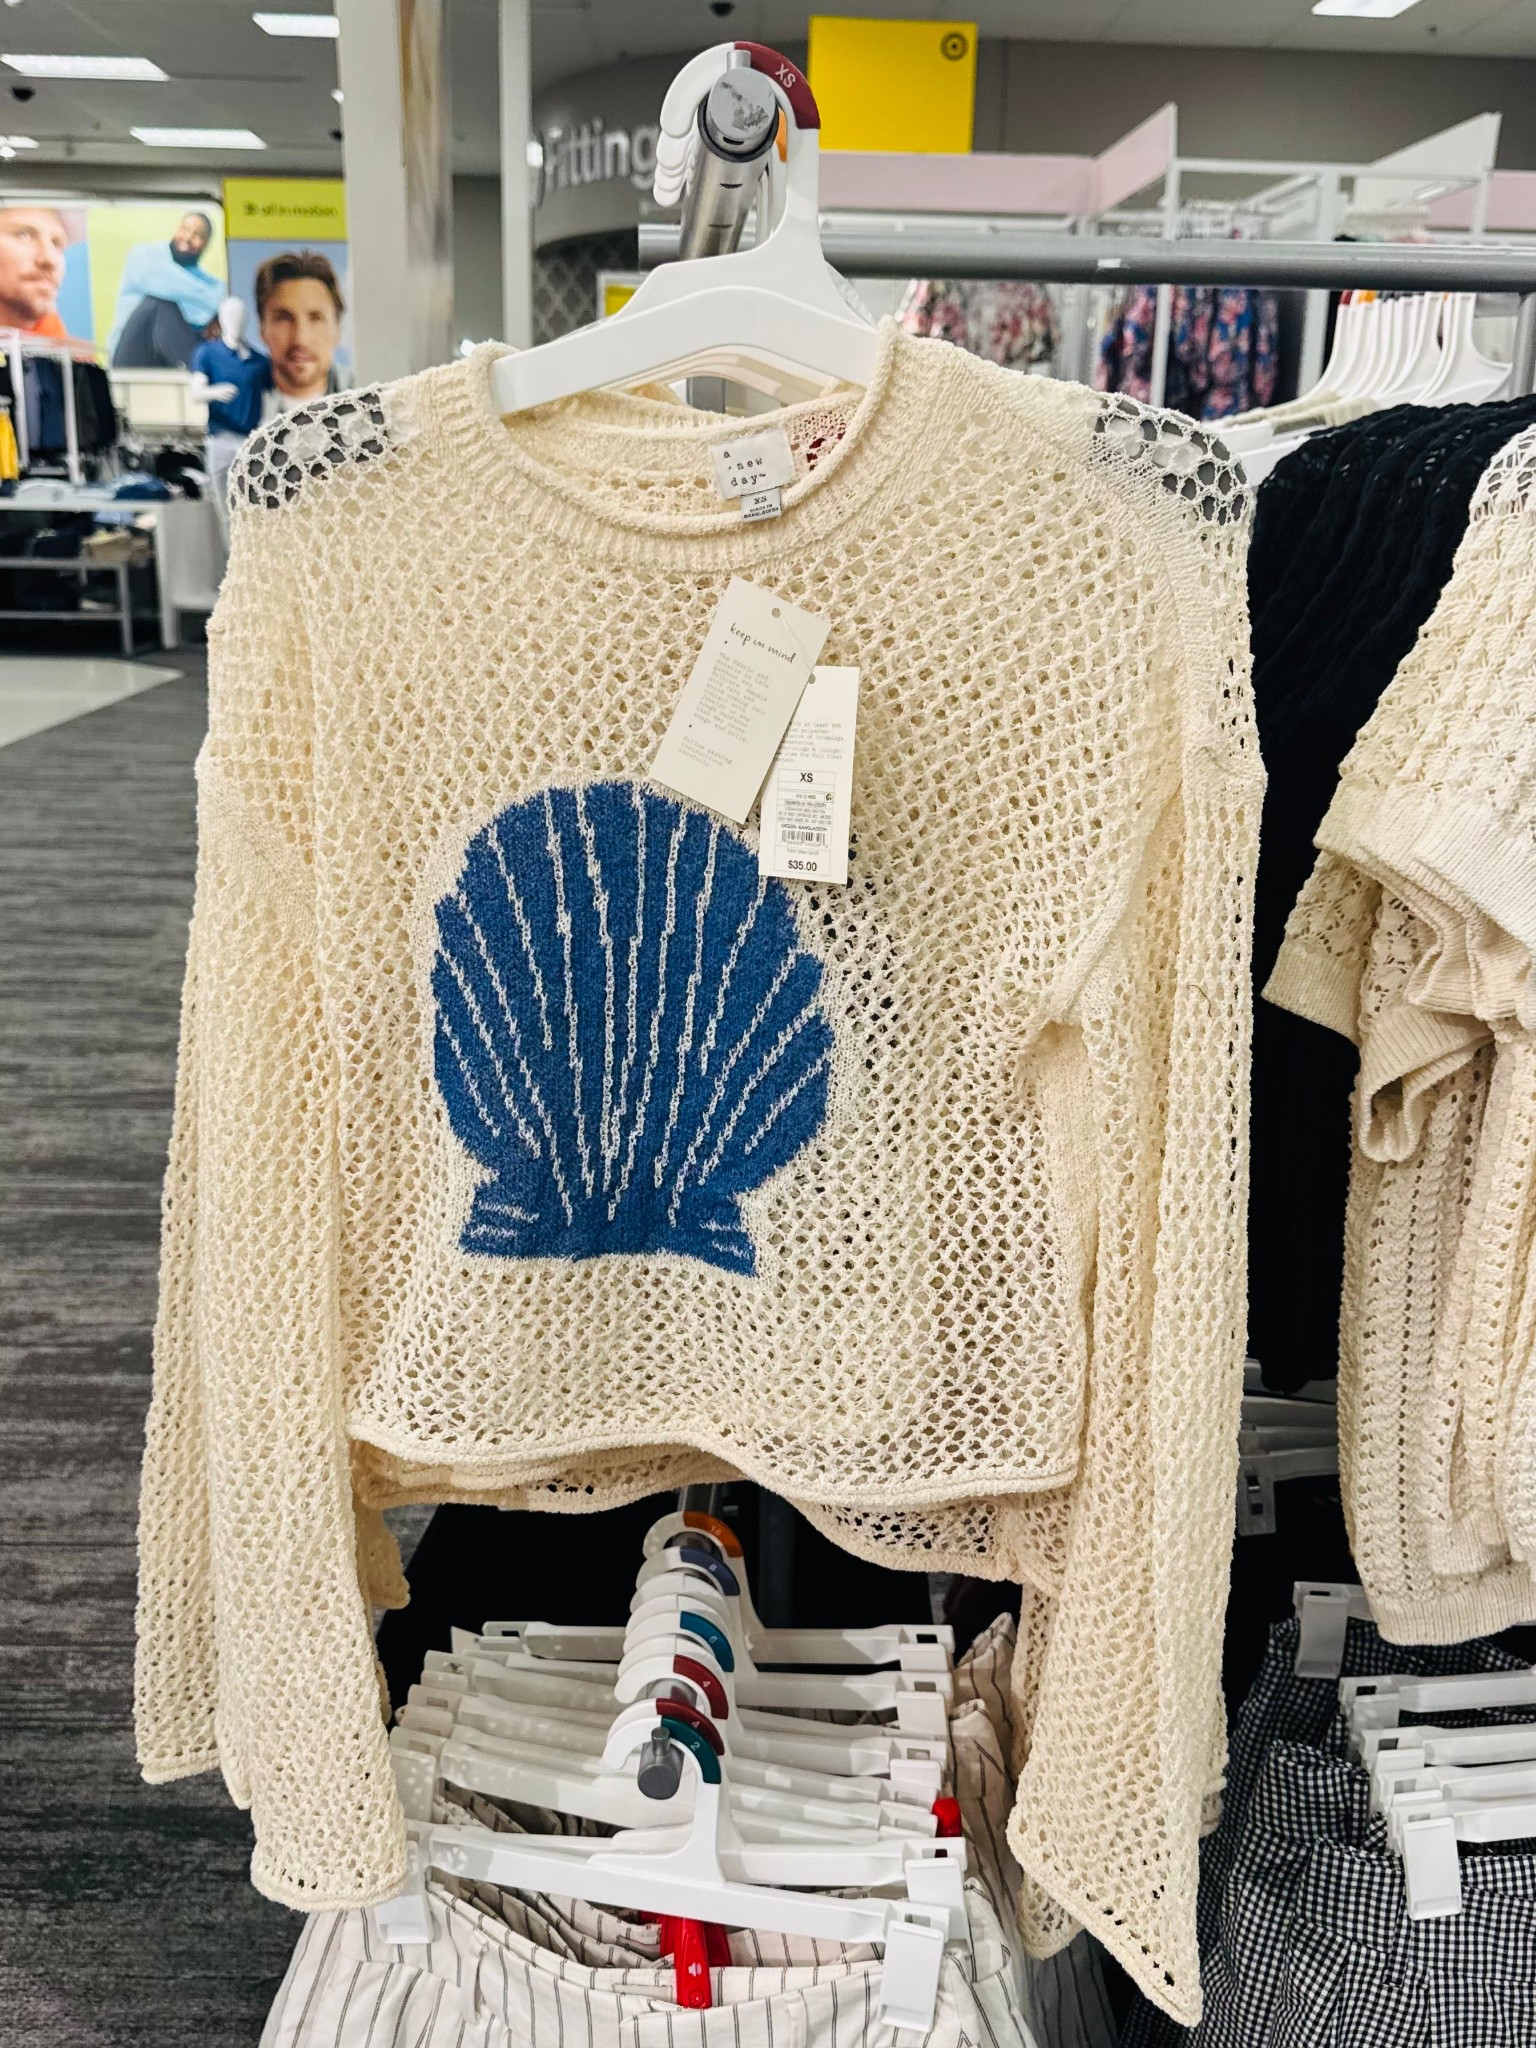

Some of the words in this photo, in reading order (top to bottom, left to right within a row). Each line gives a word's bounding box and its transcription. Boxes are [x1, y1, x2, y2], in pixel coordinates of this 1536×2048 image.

[774, 63, 797, 89] XS
[544, 116, 659, 191] Fitting
[723, 451, 731, 459] a
[736, 457, 763, 471] new
[753, 495, 768, 505] XS
[730, 622, 751, 647] keep
[753, 638, 765, 650] in
[768, 644, 797, 664] mind
[800, 772, 814, 783] XS
[788, 859, 818, 872] $35.00
[708, 1635, 718, 1644] 6
[702, 1680, 711, 1688] 4
[691, 1720, 701, 1729] 4
[690, 1741, 701, 1751] 2
